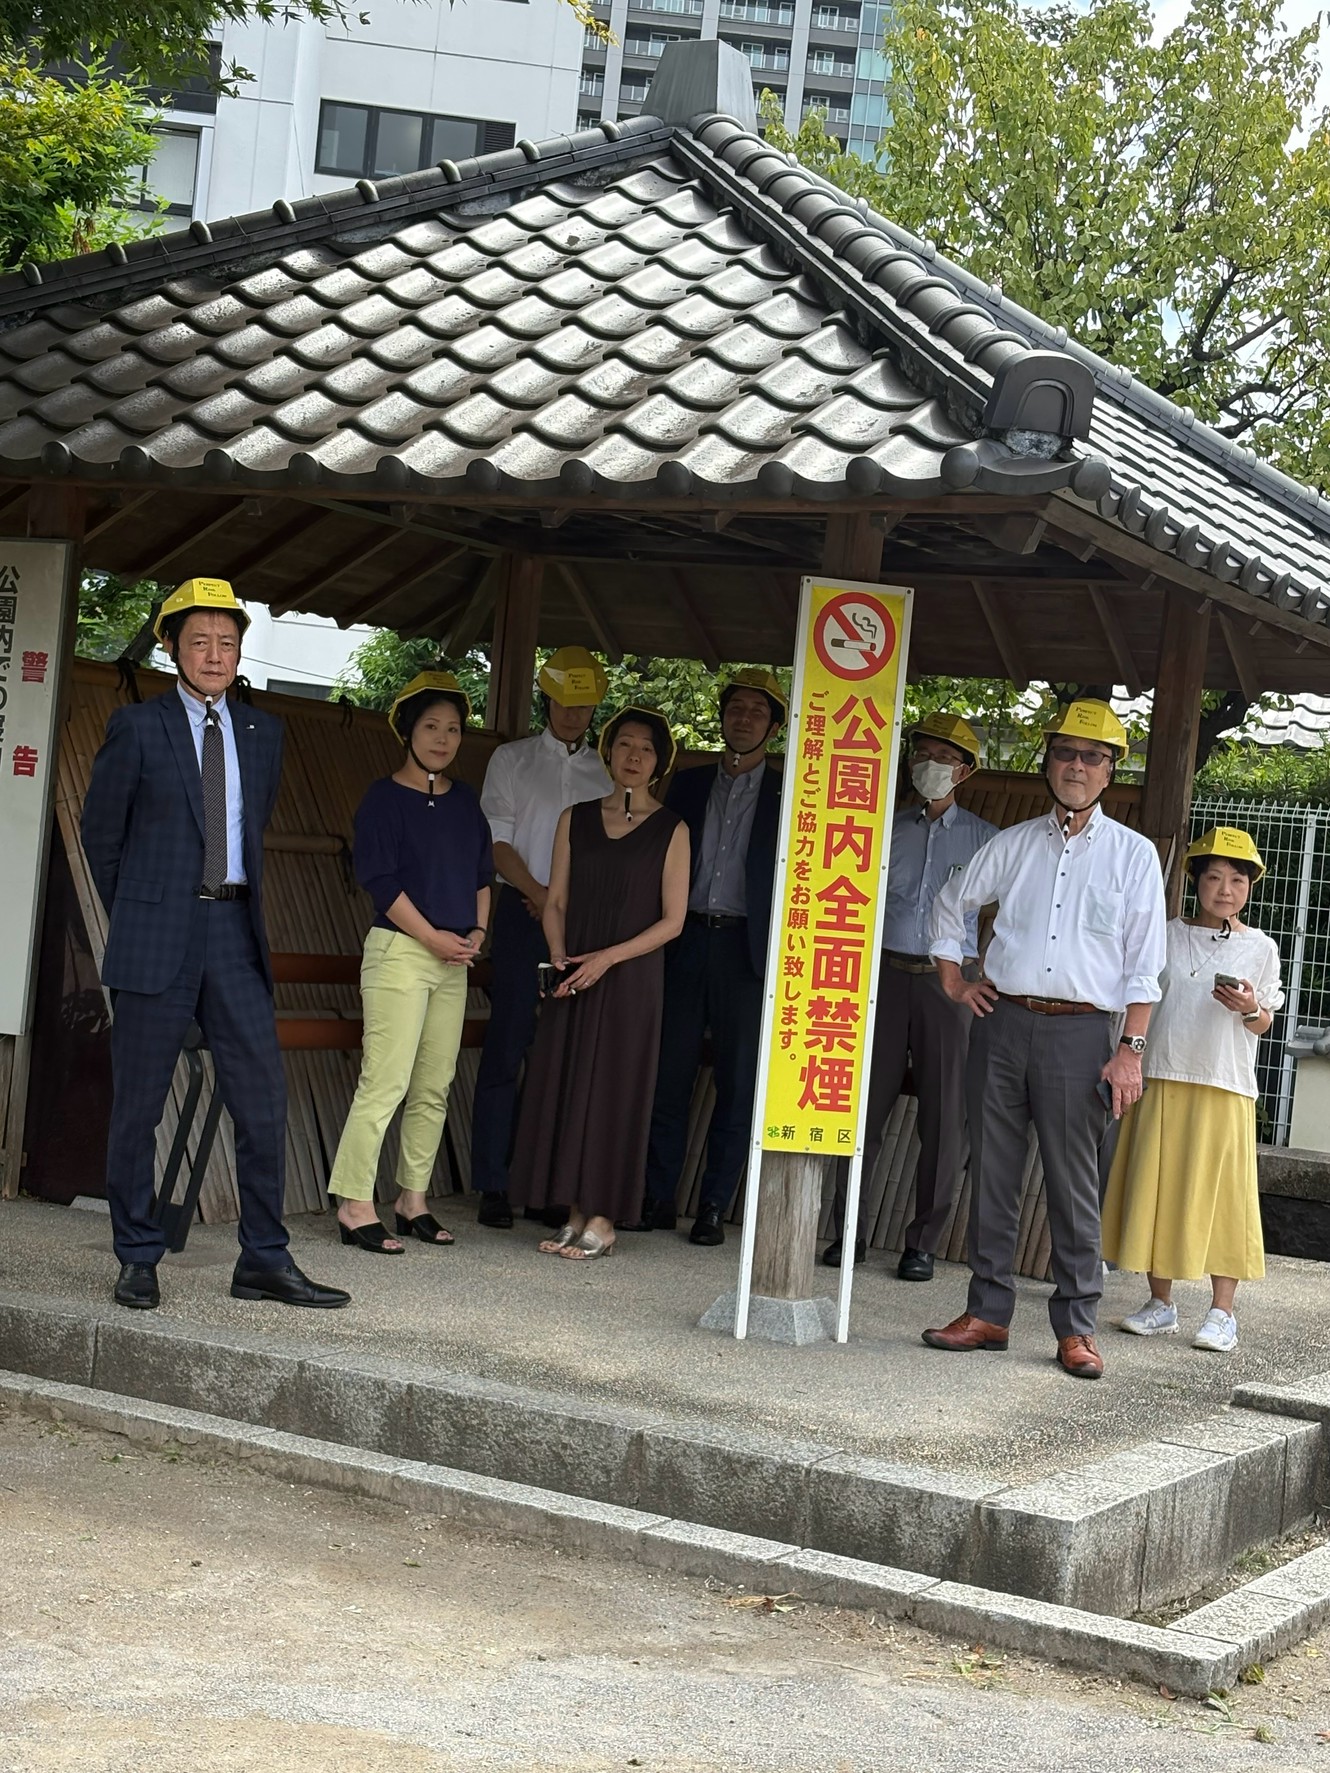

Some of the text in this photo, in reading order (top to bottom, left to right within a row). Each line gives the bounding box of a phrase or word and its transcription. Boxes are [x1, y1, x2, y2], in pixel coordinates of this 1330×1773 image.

[13, 650, 48, 777] 警告
[779, 690, 830, 1061] ご理解とご協力をお願い致します。
[797, 694, 888, 1113] 公園内全面禁煙
[781, 1125, 852, 1144] 新宿区
